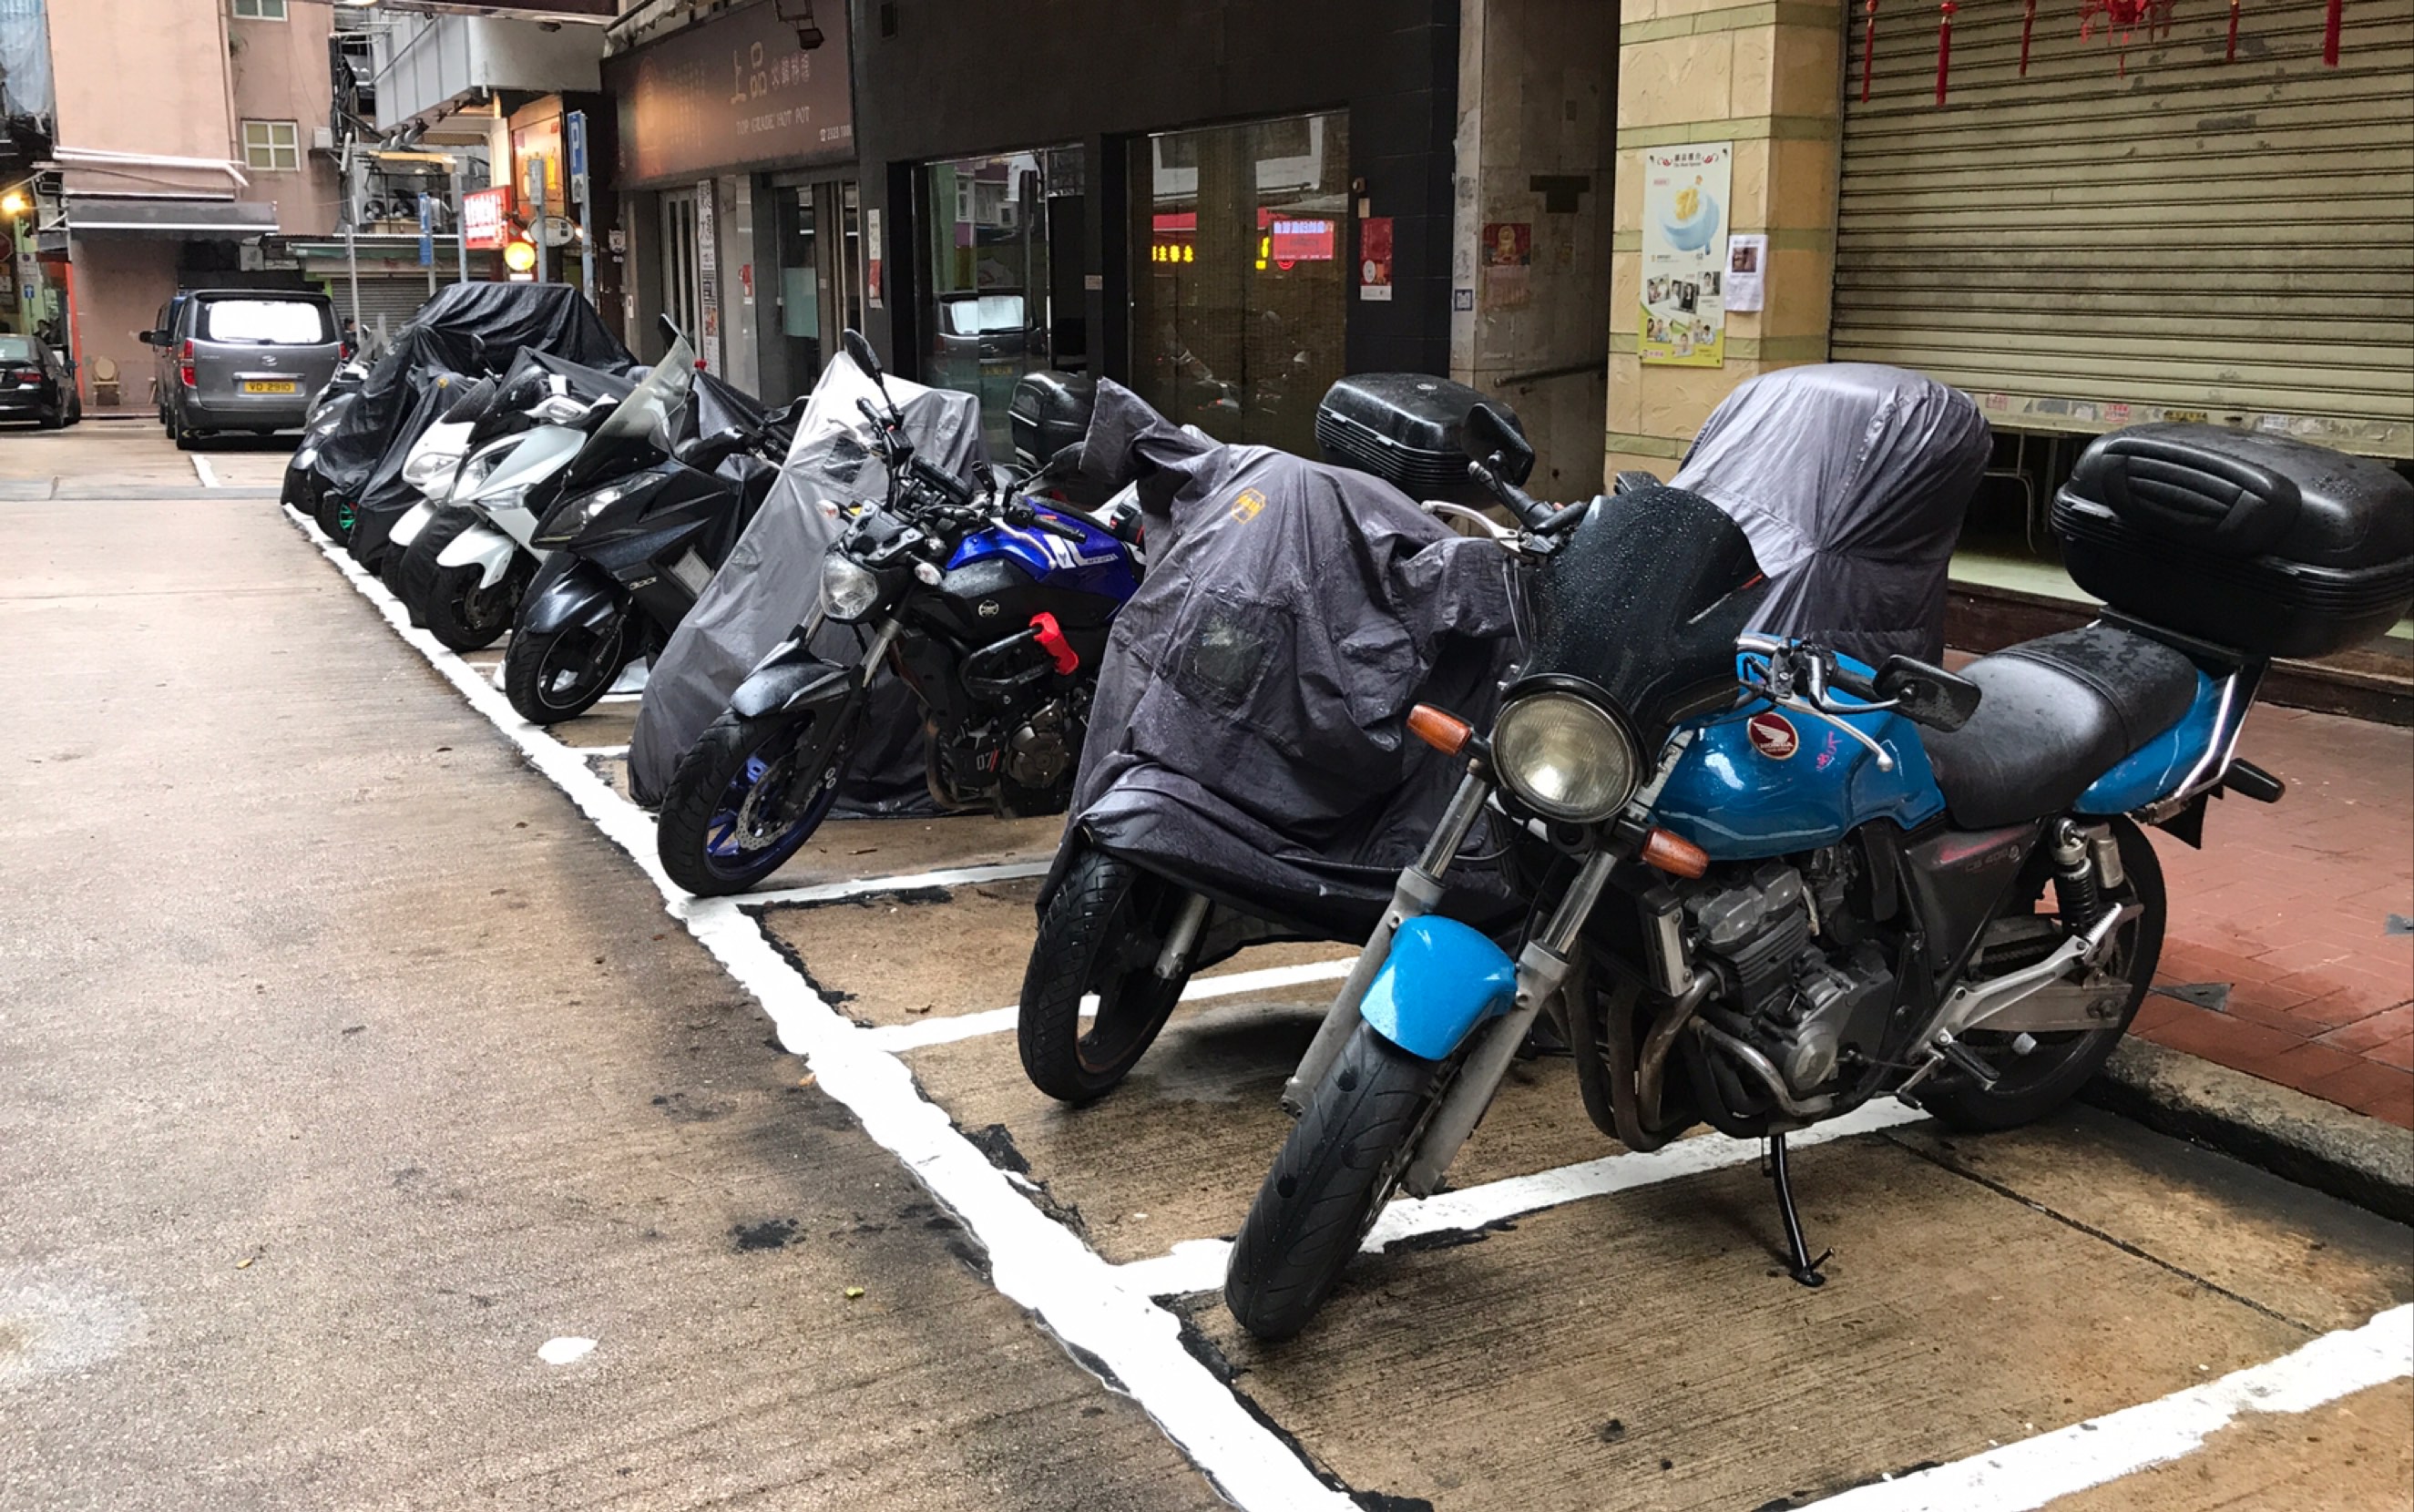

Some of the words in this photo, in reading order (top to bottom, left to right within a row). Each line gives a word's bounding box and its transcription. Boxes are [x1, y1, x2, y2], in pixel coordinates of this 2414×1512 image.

[736, 119, 749, 136] TOP
[752, 114, 775, 132] GRADE
[777, 109, 792, 128] HOT
[795, 106, 810, 124] POT
